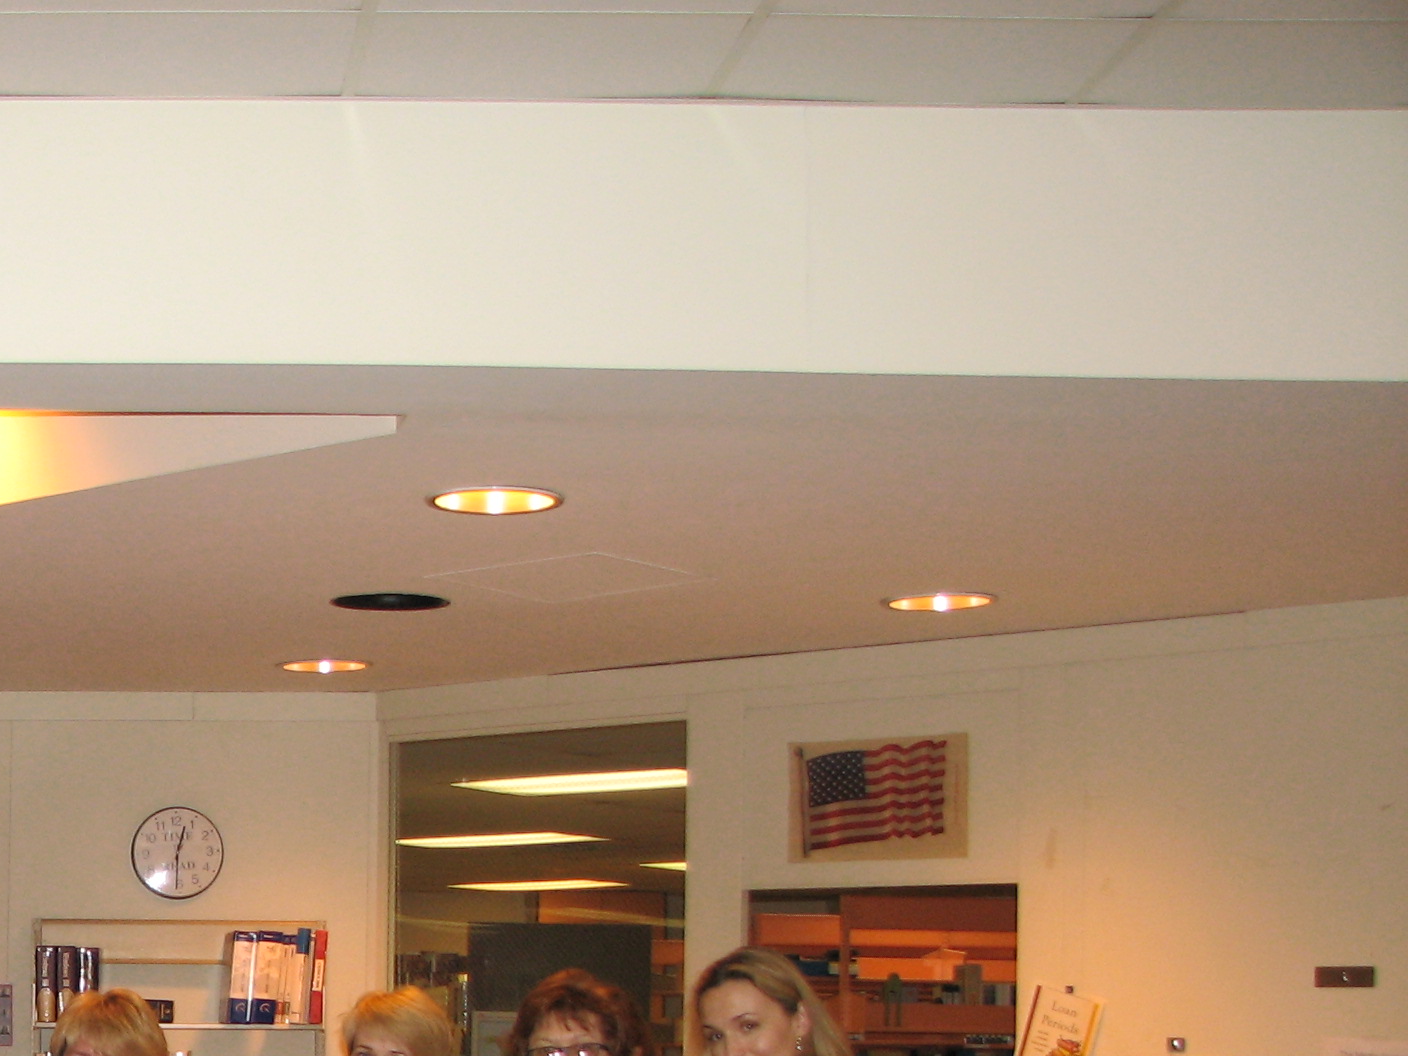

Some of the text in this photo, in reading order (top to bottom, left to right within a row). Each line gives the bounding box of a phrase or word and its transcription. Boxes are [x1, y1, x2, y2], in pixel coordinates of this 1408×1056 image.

[155, 821, 165, 831] 11
[171, 816, 182, 826] 12
[201, 830, 209, 841] 2
[206, 846, 214, 856] 3
[202, 861, 210, 872] 4
[192, 874, 199, 884] 5
[1051, 1000, 1078, 1018] Loan
[1041, 1013, 1080, 1035] Periods
